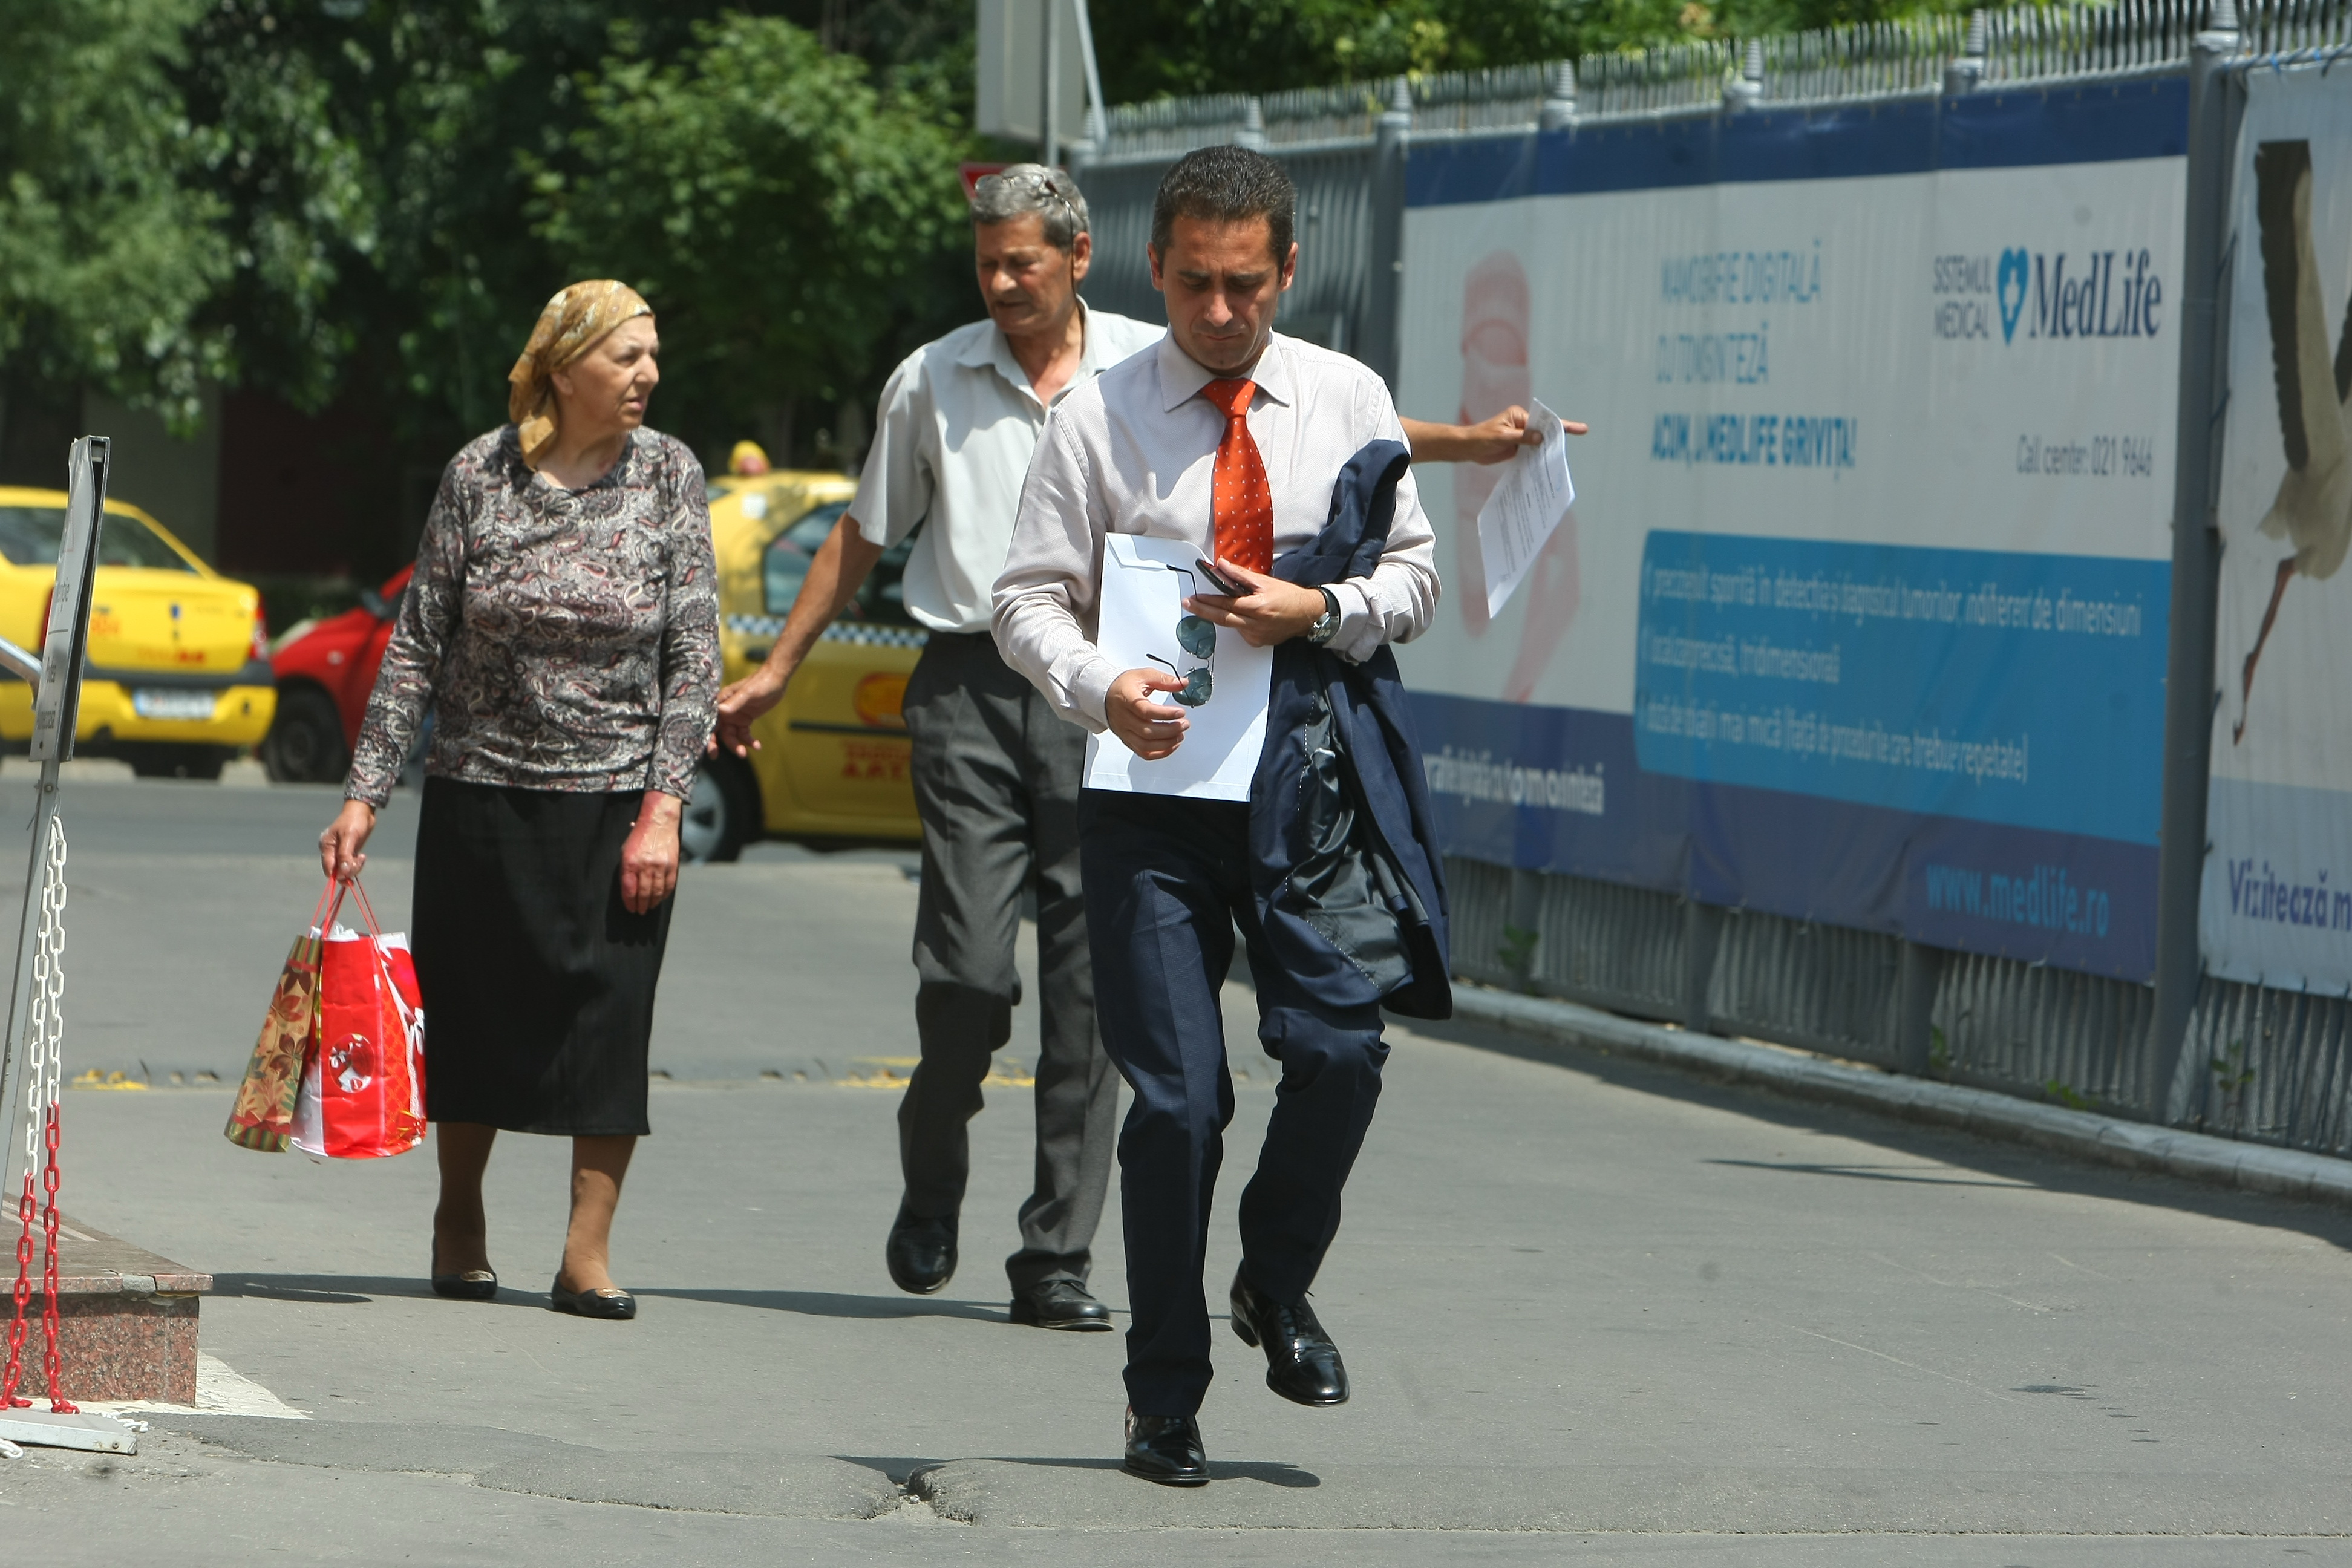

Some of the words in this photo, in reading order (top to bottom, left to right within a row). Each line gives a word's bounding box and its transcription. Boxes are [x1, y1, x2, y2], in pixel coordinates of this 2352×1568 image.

[1933, 254, 1992, 295] SISTEMUL
[2028, 247, 2163, 339] MedLife
[1933, 301, 1990, 340] MEDICAL
[2016, 434, 2041, 475] Call
[2091, 436, 2117, 477] 021
[2122, 436, 2154, 479] 9646
[1925, 861, 2110, 938] www.medlife.ro
[2227, 857, 2328, 929] Vizitează
